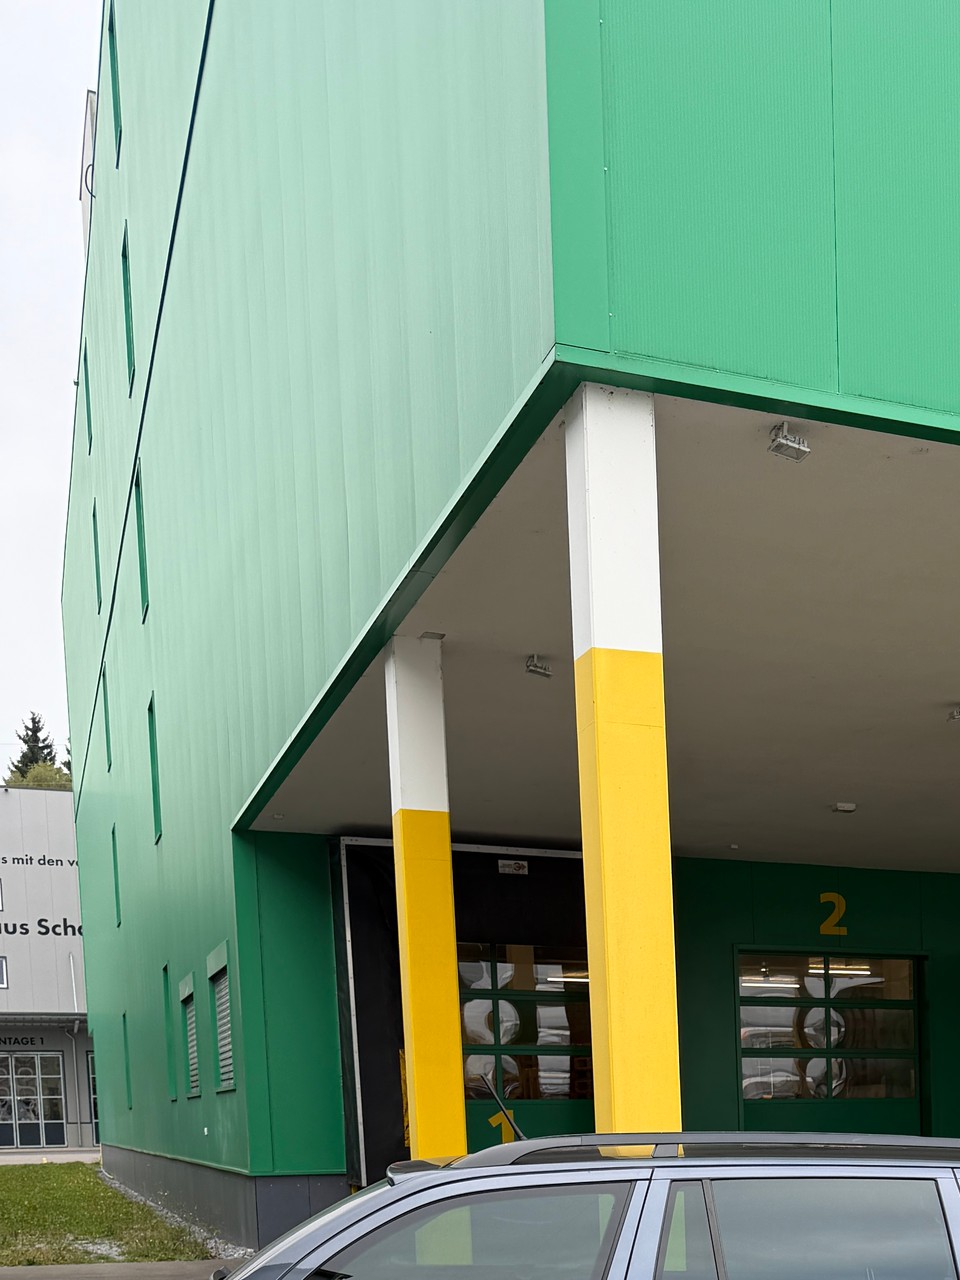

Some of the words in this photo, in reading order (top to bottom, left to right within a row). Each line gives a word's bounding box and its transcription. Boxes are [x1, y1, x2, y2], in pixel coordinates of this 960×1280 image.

[12, 854, 34, 865] mit
[37, 854, 64, 866] den
[819, 892, 848, 936] 2
[0, 923, 30, 936] us
[40, 1037, 44, 1045] 1
[487, 1109, 515, 1145] 1
